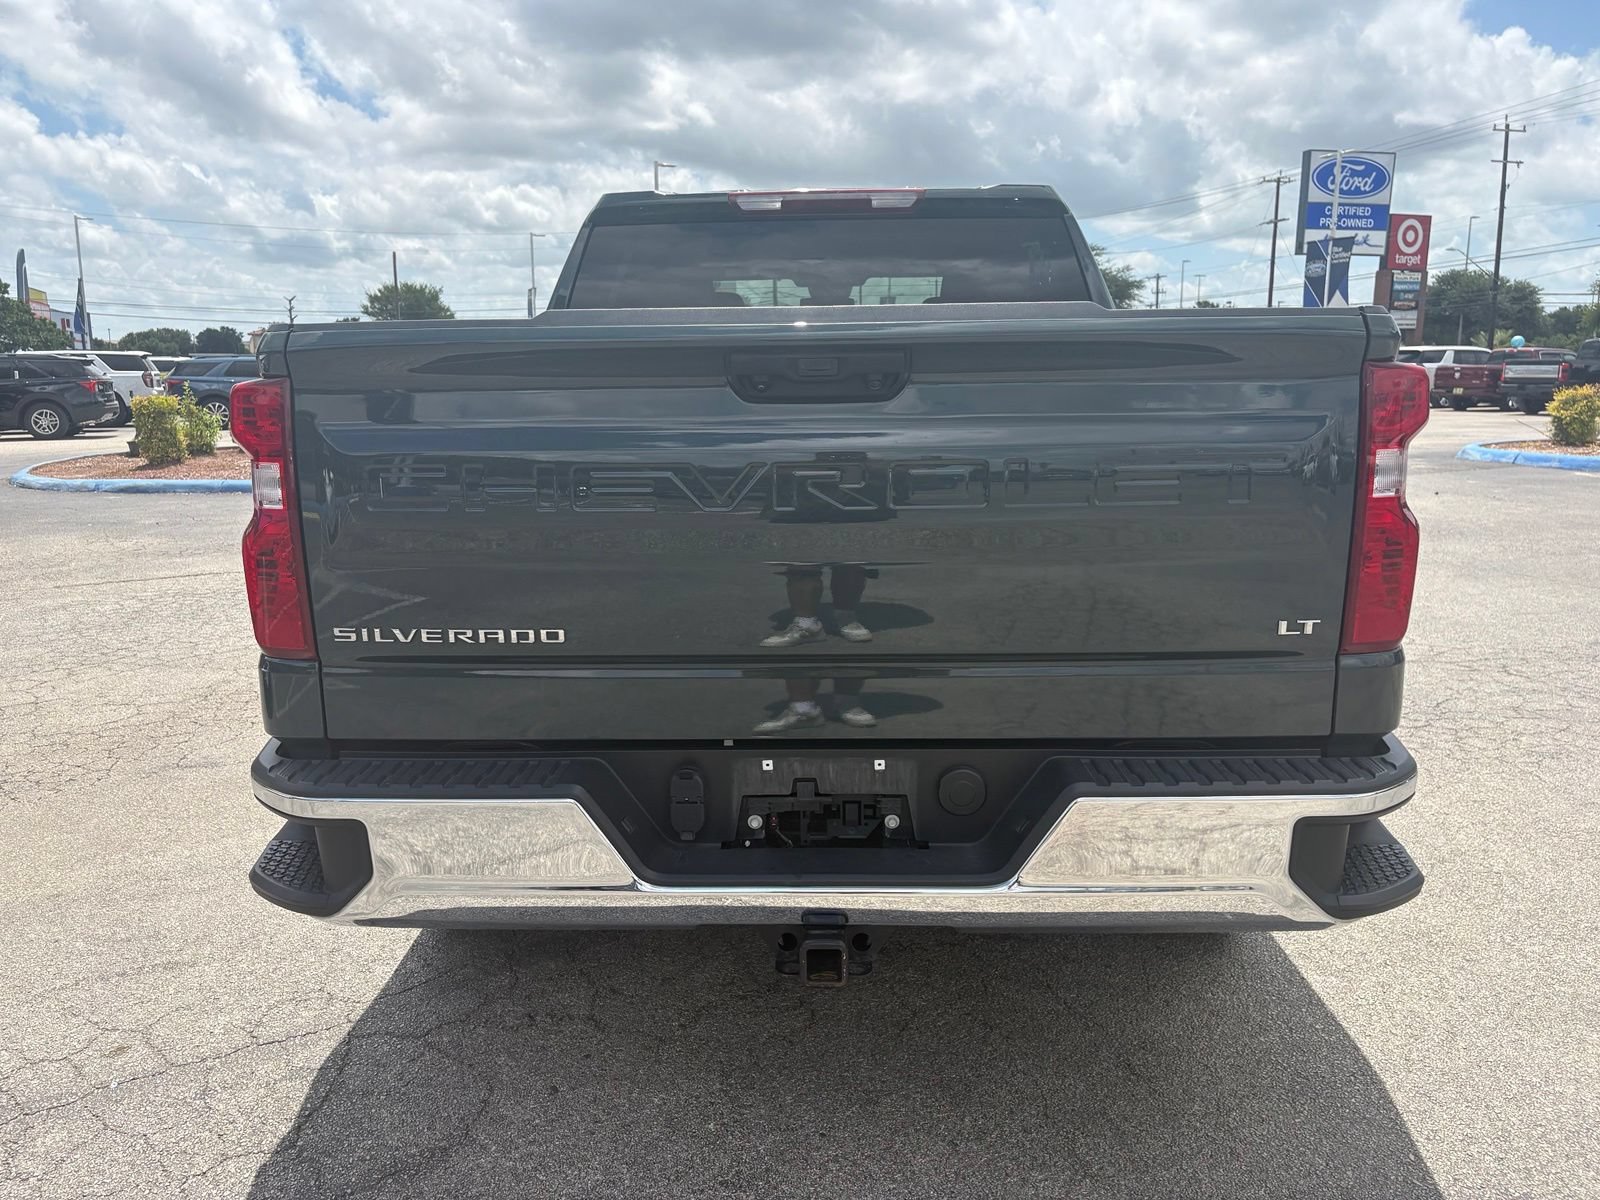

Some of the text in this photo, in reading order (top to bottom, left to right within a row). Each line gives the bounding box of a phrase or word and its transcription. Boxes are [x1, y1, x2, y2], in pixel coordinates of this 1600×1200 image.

[1327, 162, 1377, 192] Ford
[1324, 205, 1372, 216] CRTIFIED
[1394, 253, 1421, 267] target
[1278, 620, 1321, 635] LT
[333, 627, 566, 644] SILVERADO
